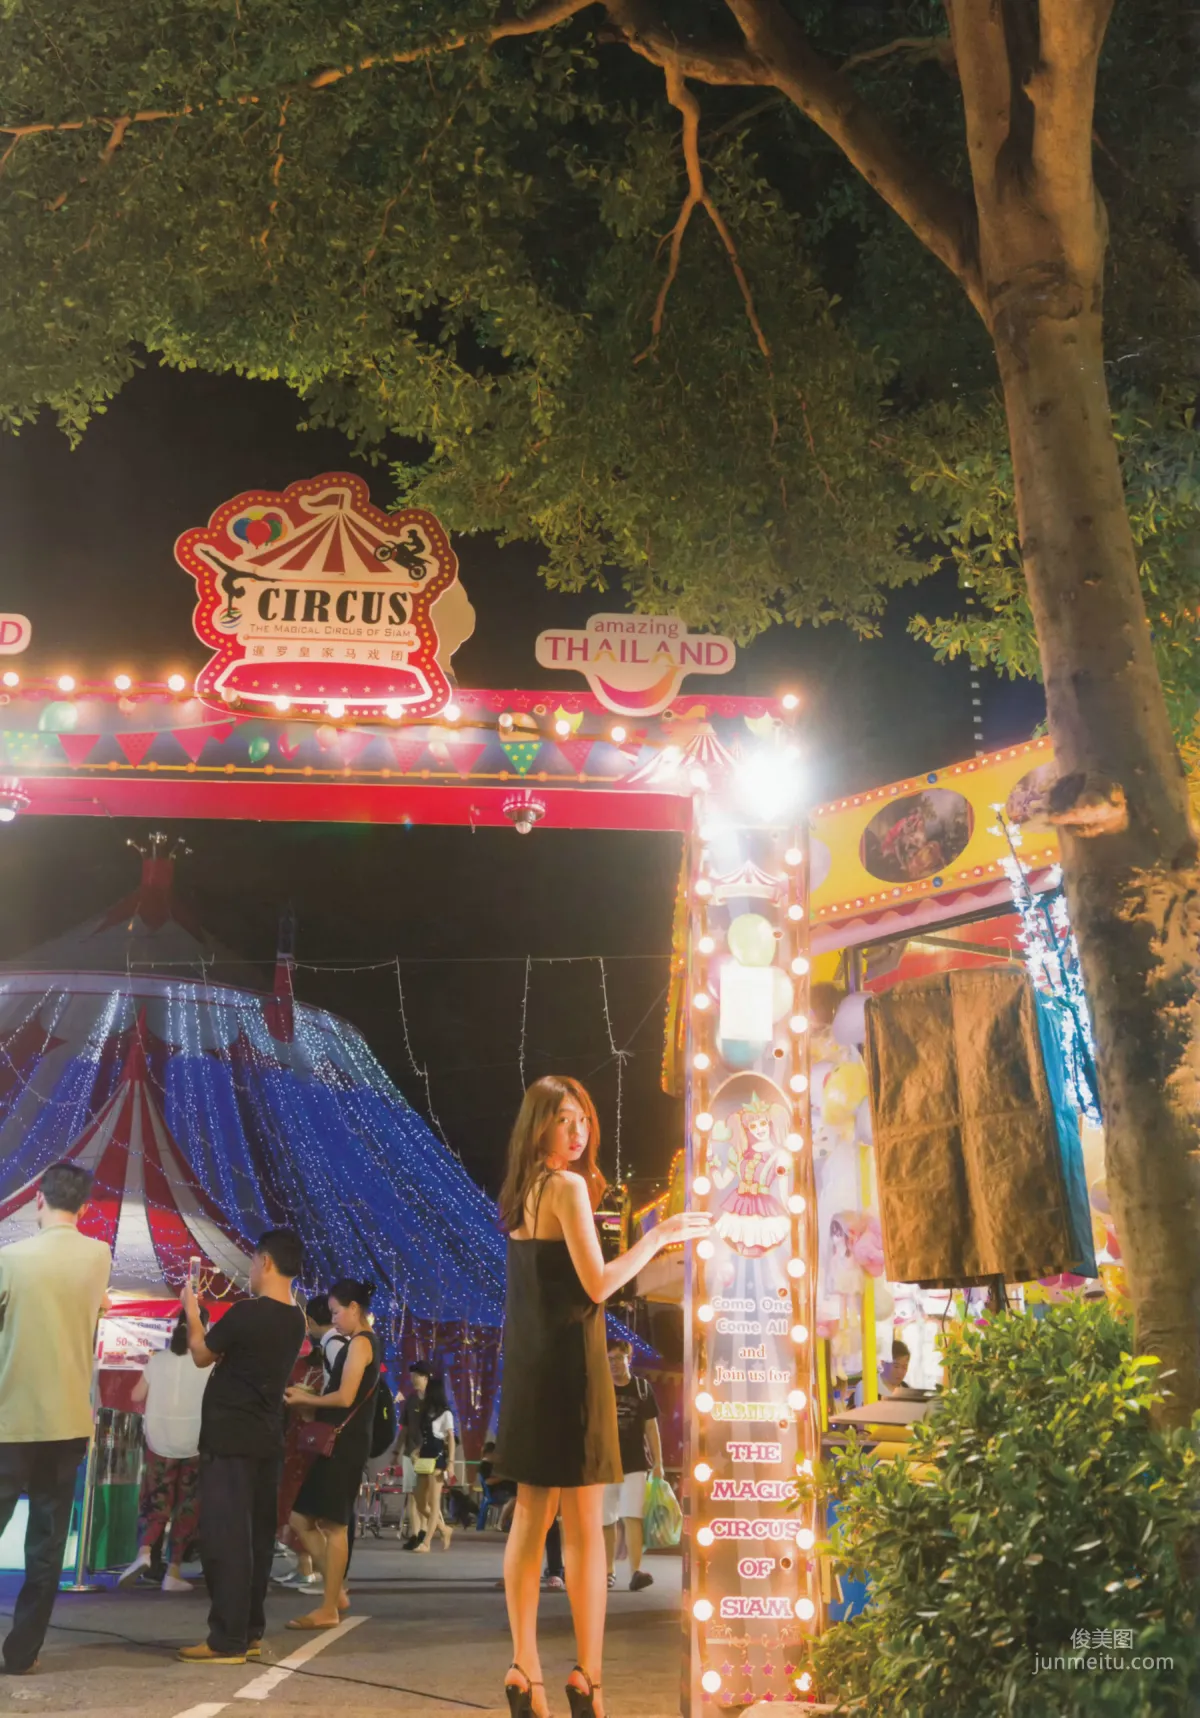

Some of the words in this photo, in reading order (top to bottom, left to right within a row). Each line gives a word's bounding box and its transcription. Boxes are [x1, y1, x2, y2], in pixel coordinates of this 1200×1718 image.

[257, 587, 408, 626] CIRCUS
[250, 623, 270, 633] THE
[274, 624, 320, 634] MAGICAL
[324, 625, 363, 637] CIRCUS
[384, 628, 411, 637] SIAM
[594, 619, 679, 639] amazing
[252, 644, 403, 661] 暹罗皇家马戏团
[544, 636, 729, 666] THAILAND
[712, 1296, 755, 1312] Come
[716, 1317, 761, 1334] Come
[766, 1319, 788, 1335] All
[739, 1345, 766, 1359] and
[714, 1366, 745, 1385] Join
[749, 1370, 765, 1382] us
[767, 1367, 791, 1382] for
[728, 1443, 781, 1461] THE
[712, 1481, 797, 1501] MAGIC
[710, 1519, 801, 1539] CIRCUS
[739, 1559, 774, 1578] OF
[721, 1597, 793, 1618] SIAM
